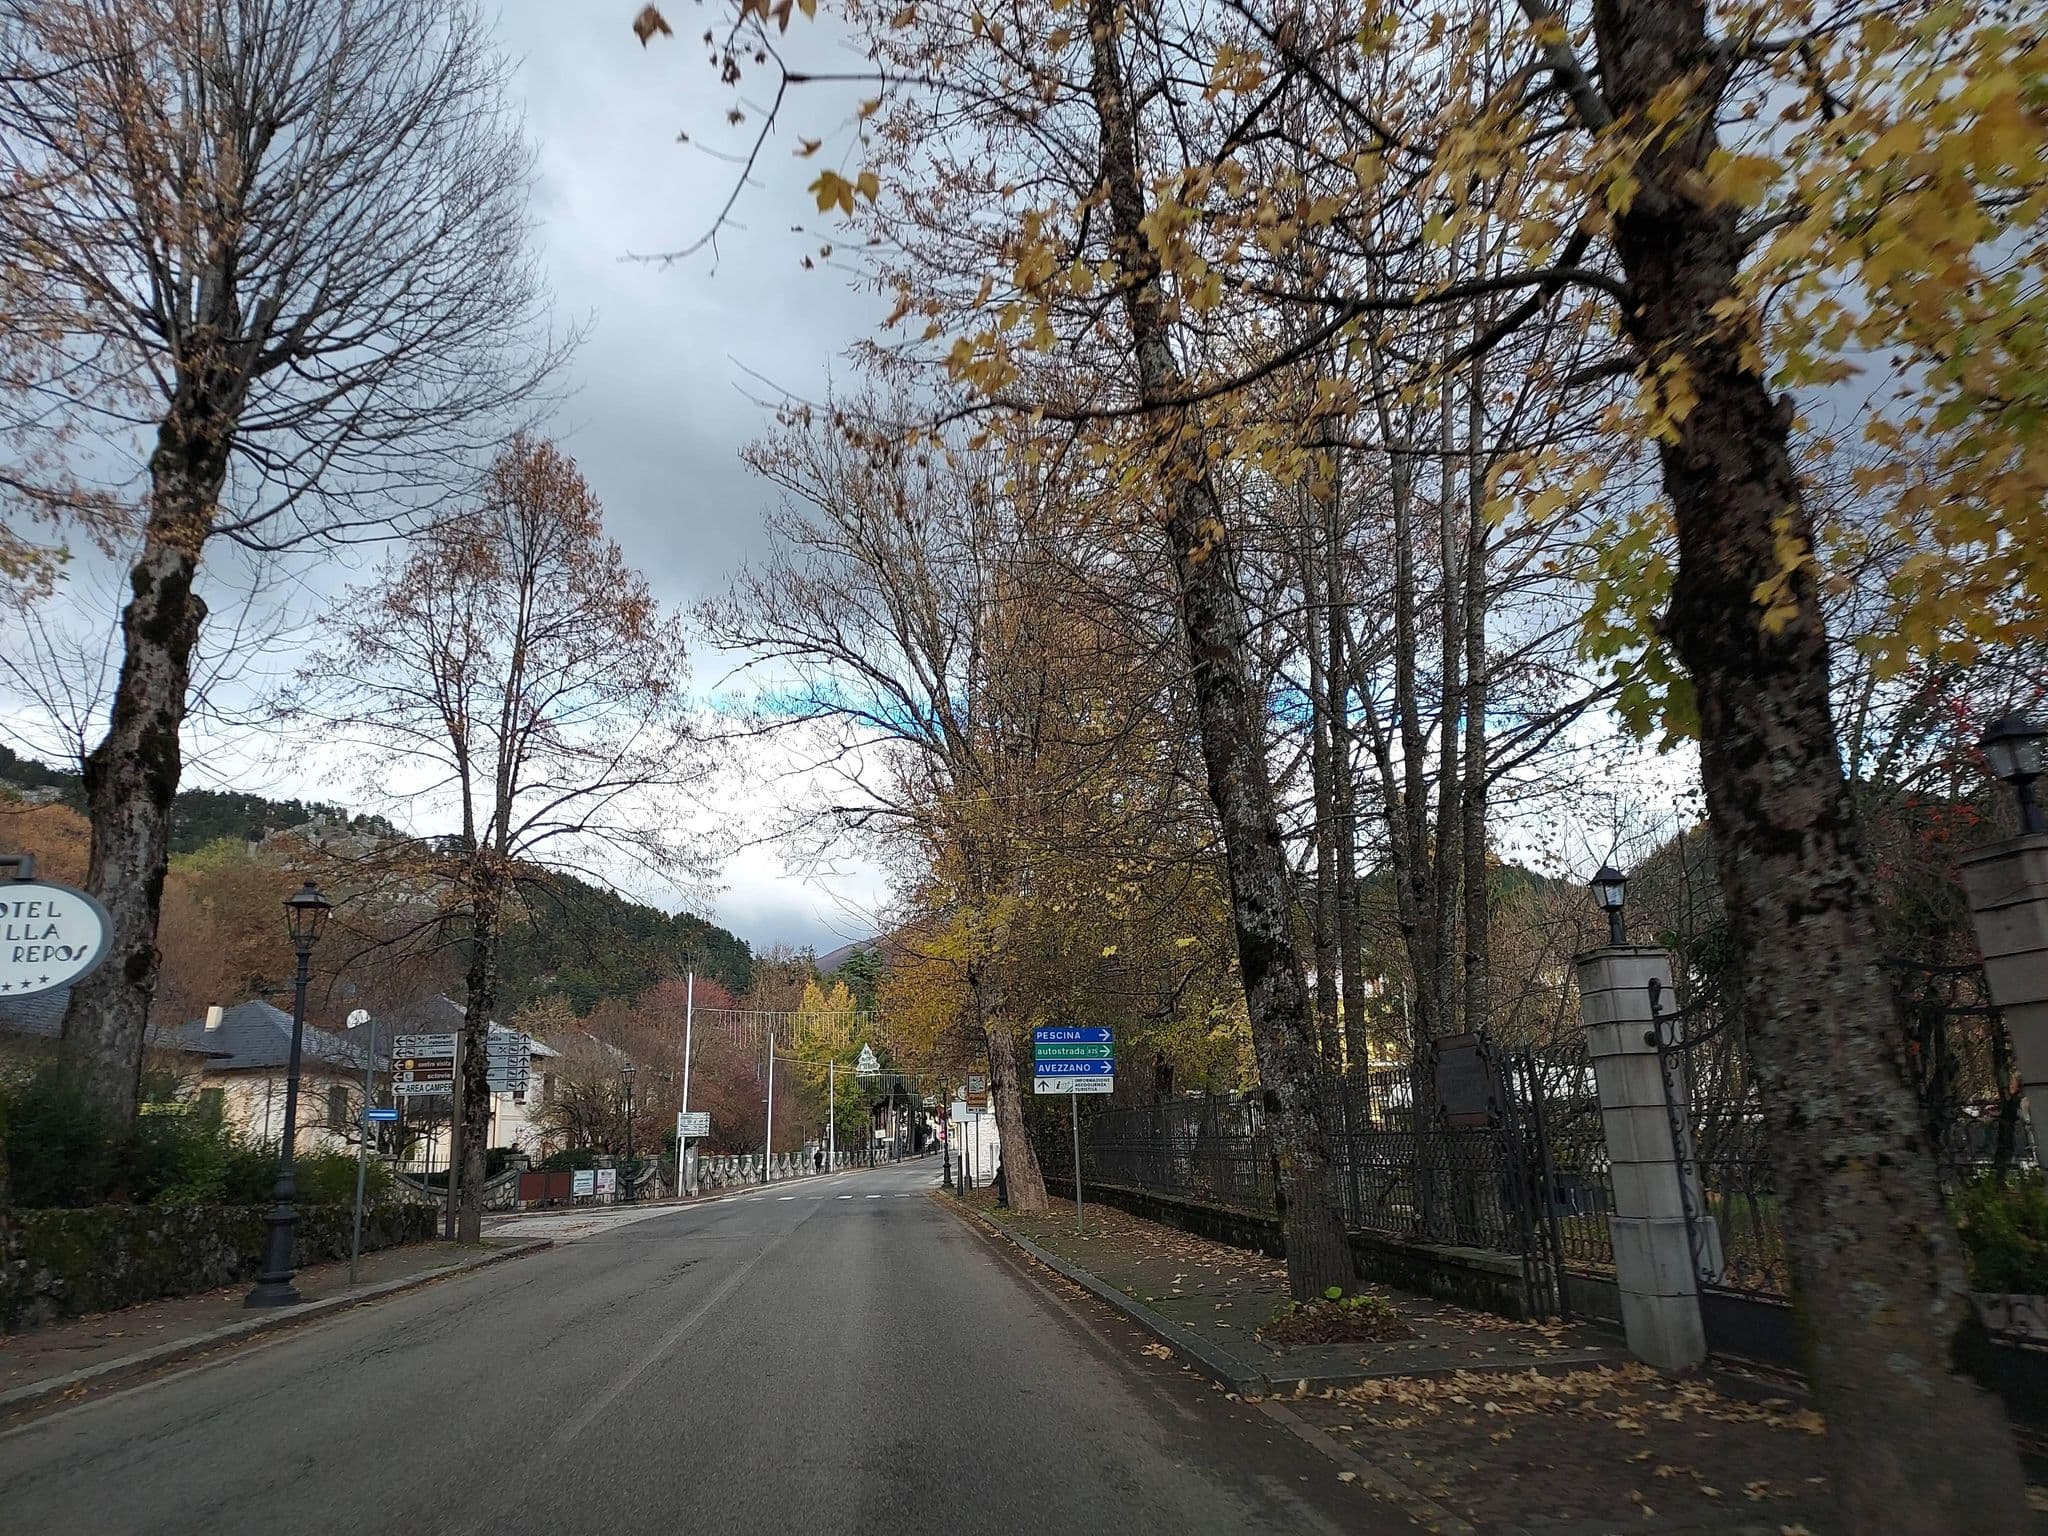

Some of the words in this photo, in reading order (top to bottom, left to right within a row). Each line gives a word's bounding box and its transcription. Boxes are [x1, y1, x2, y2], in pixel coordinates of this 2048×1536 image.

[12, 945, 89, 962] REPOS
[1036, 1031, 1081, 1040] PESCINA
[1037, 1047, 1085, 1055] autostrada
[1038, 1064, 1091, 1072] AVEZZANO
[406, 1084, 424, 1092] AREA
